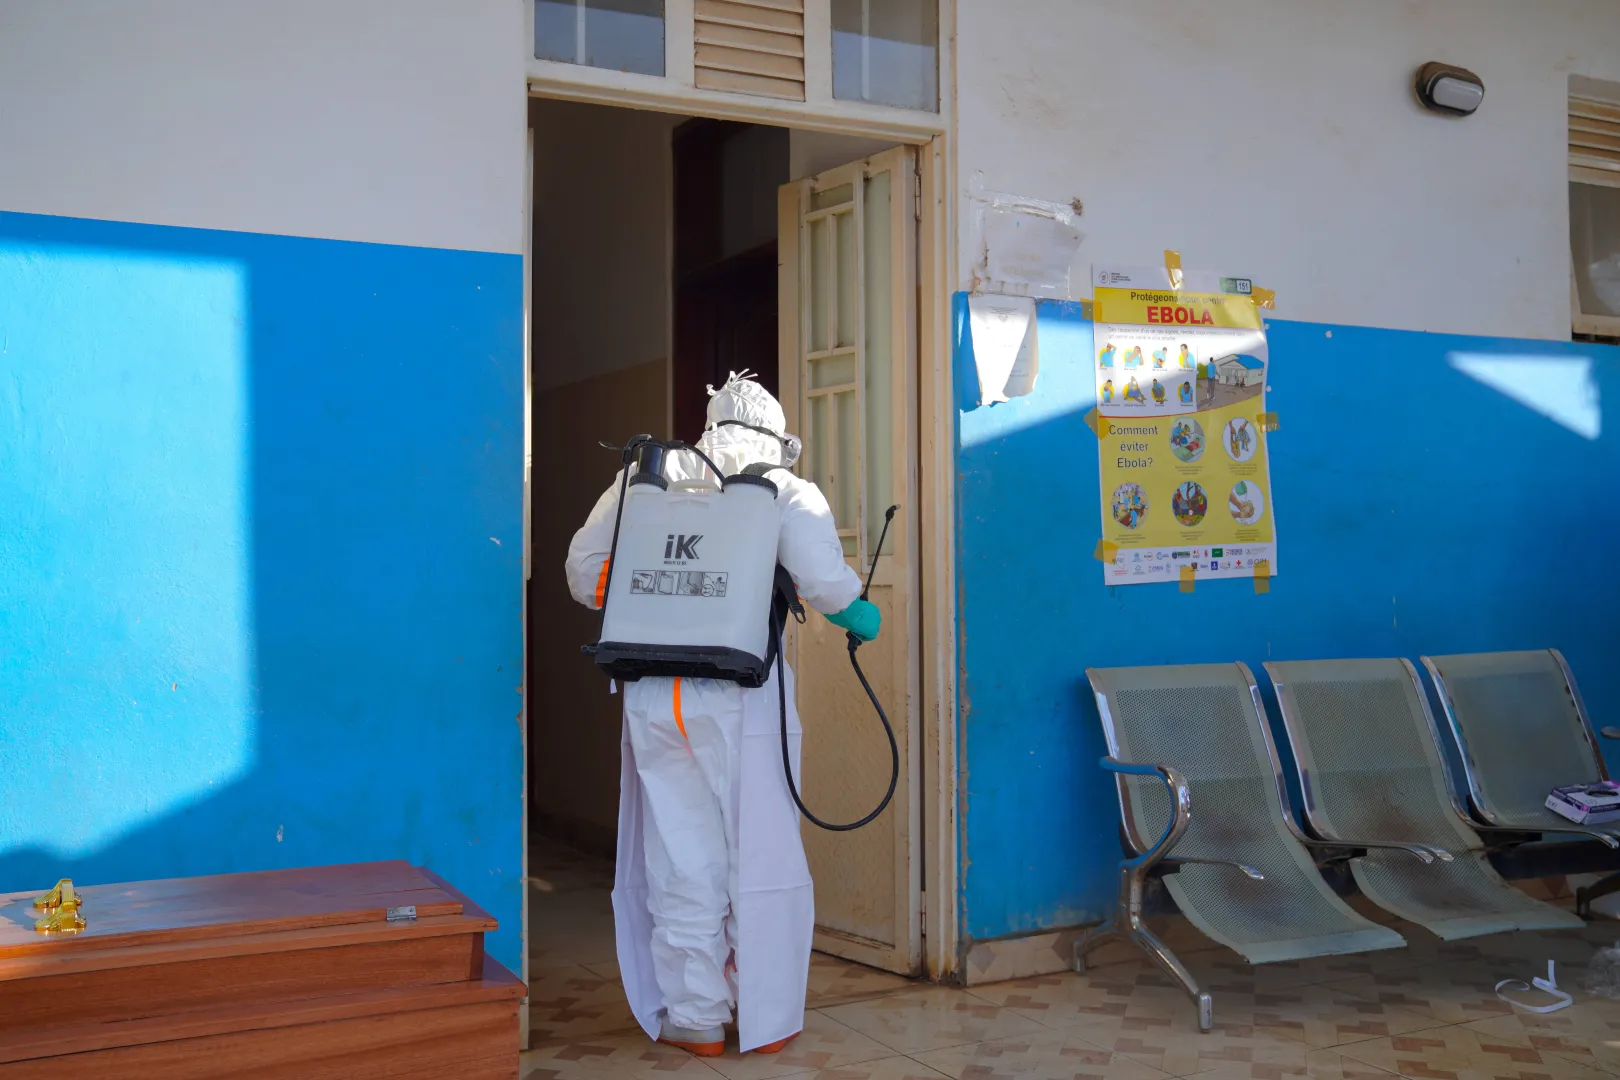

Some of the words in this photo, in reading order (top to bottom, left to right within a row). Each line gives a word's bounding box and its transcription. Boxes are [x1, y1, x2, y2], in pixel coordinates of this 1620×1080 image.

[1238, 282, 1249, 291] 151
[1147, 306, 1214, 325] EBOLA
[1109, 424, 1158, 435] Comment
[1120, 441, 1149, 452] éviter
[1117, 457, 1154, 468] Ebola?
